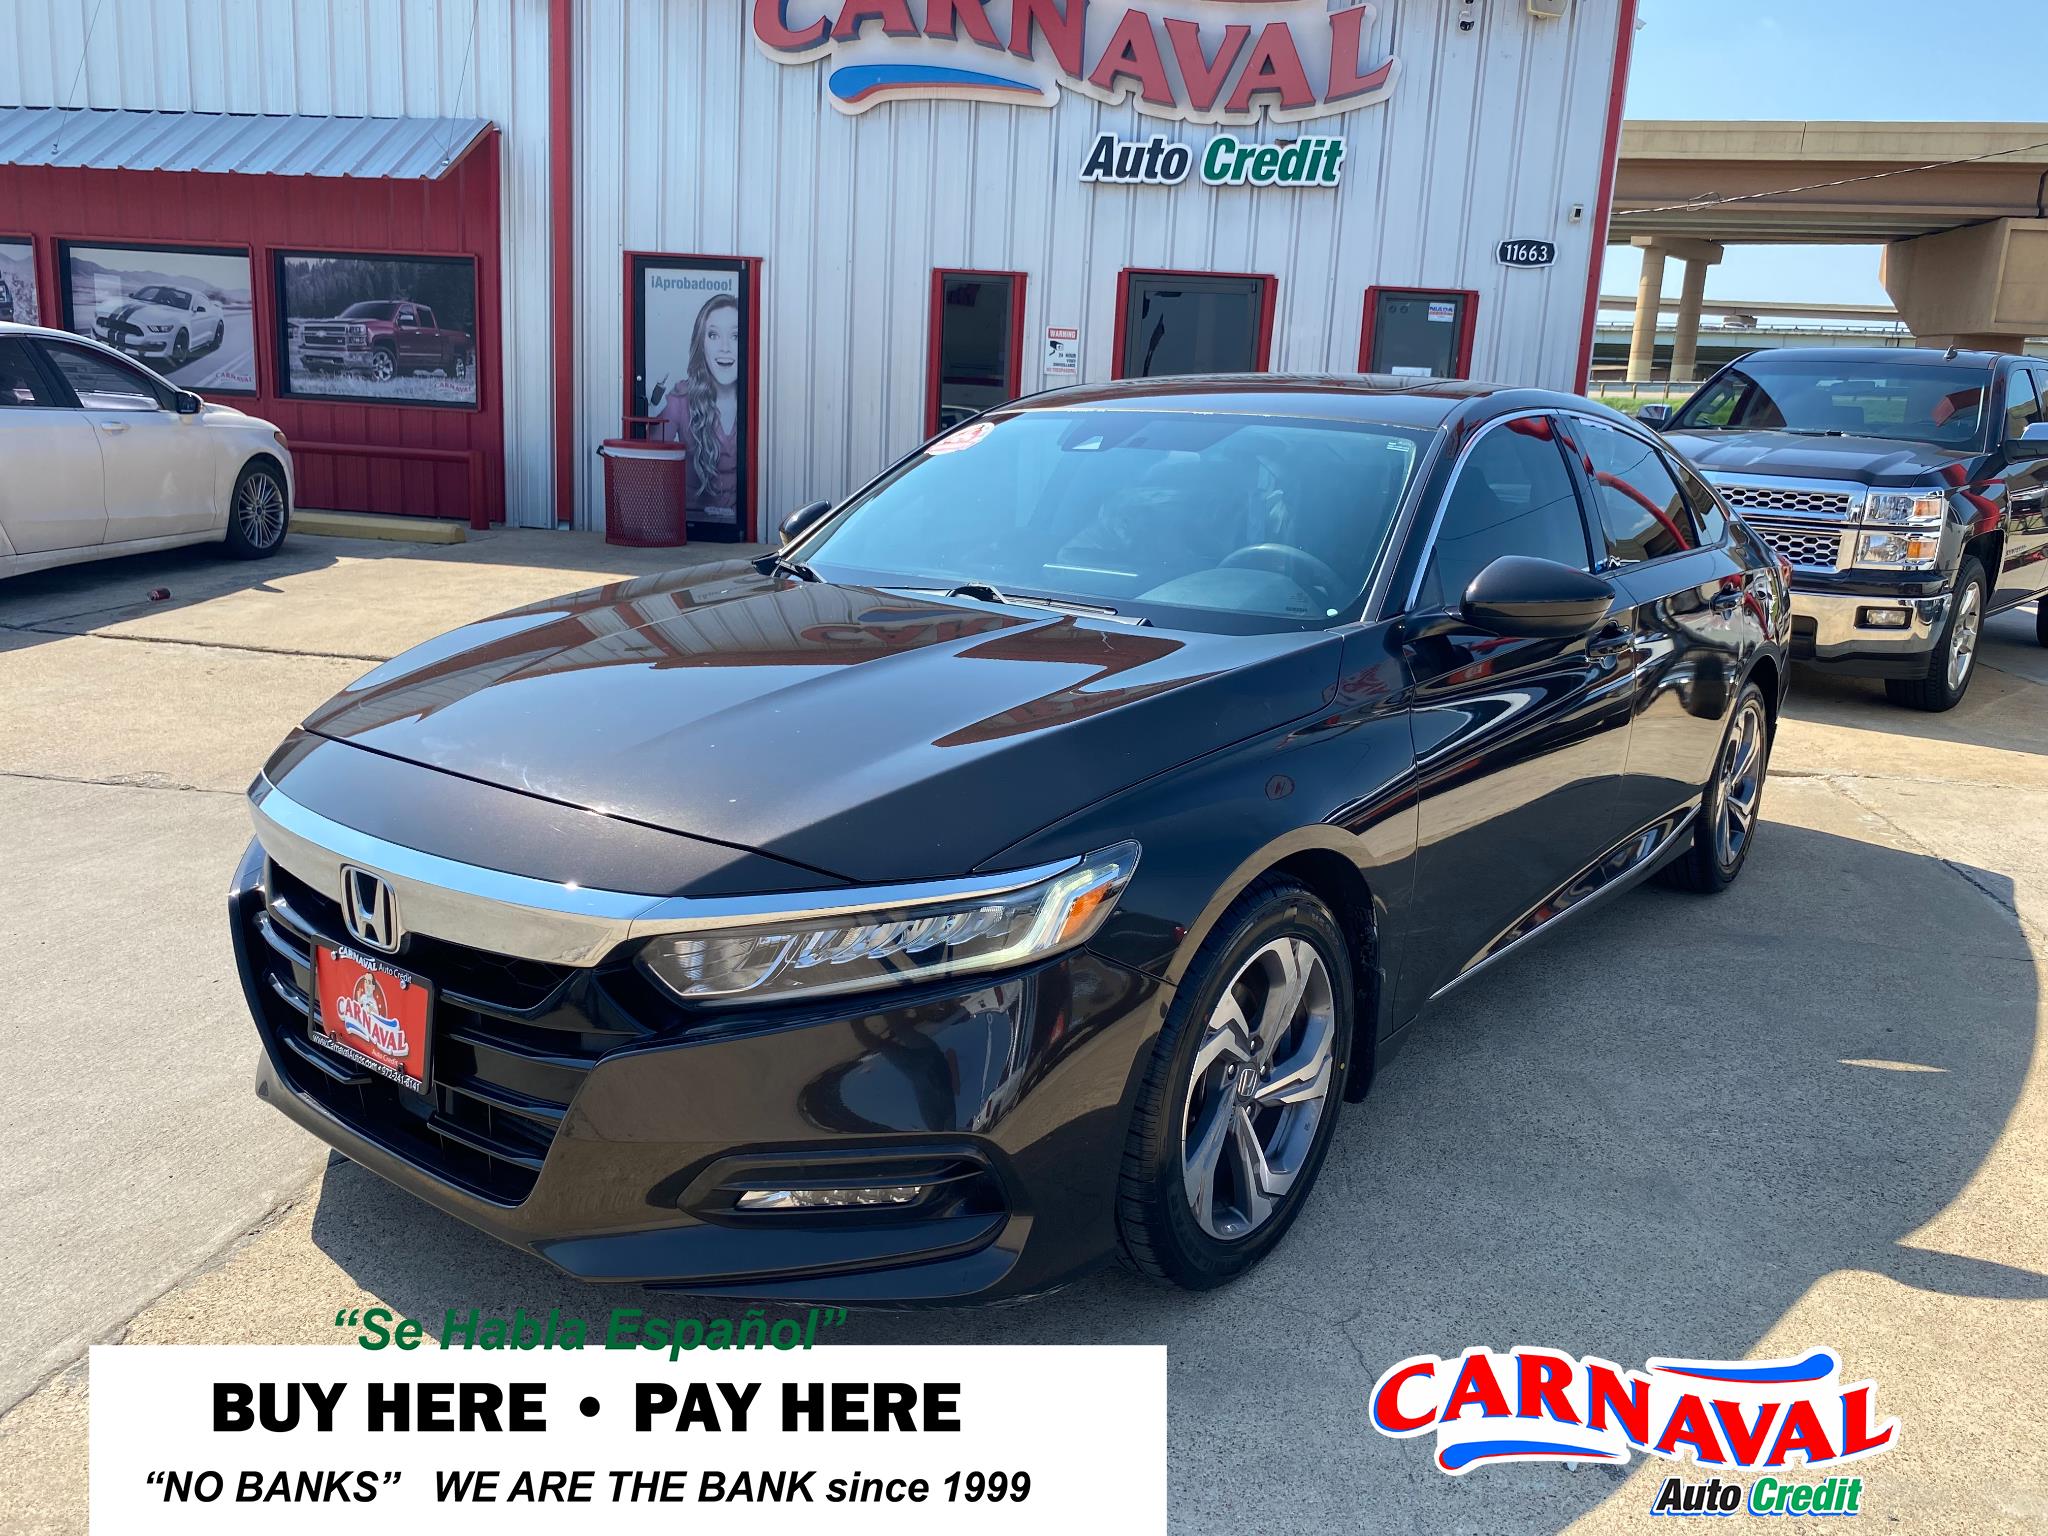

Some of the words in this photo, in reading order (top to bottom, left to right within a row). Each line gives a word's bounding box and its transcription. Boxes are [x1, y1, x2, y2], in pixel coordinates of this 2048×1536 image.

[1082, 136, 1189, 179] Auto
[1203, 138, 1342, 183] Credit
[1505, 244, 1548, 262] 11663
[1050, 329, 1076, 338] WARNING
[338, 946, 378, 972] CARNAVAL
[378, 964, 394, 977] Auto
[393, 968, 412, 984] Credit
[337, 996, 409, 1056] CARNAVAL
